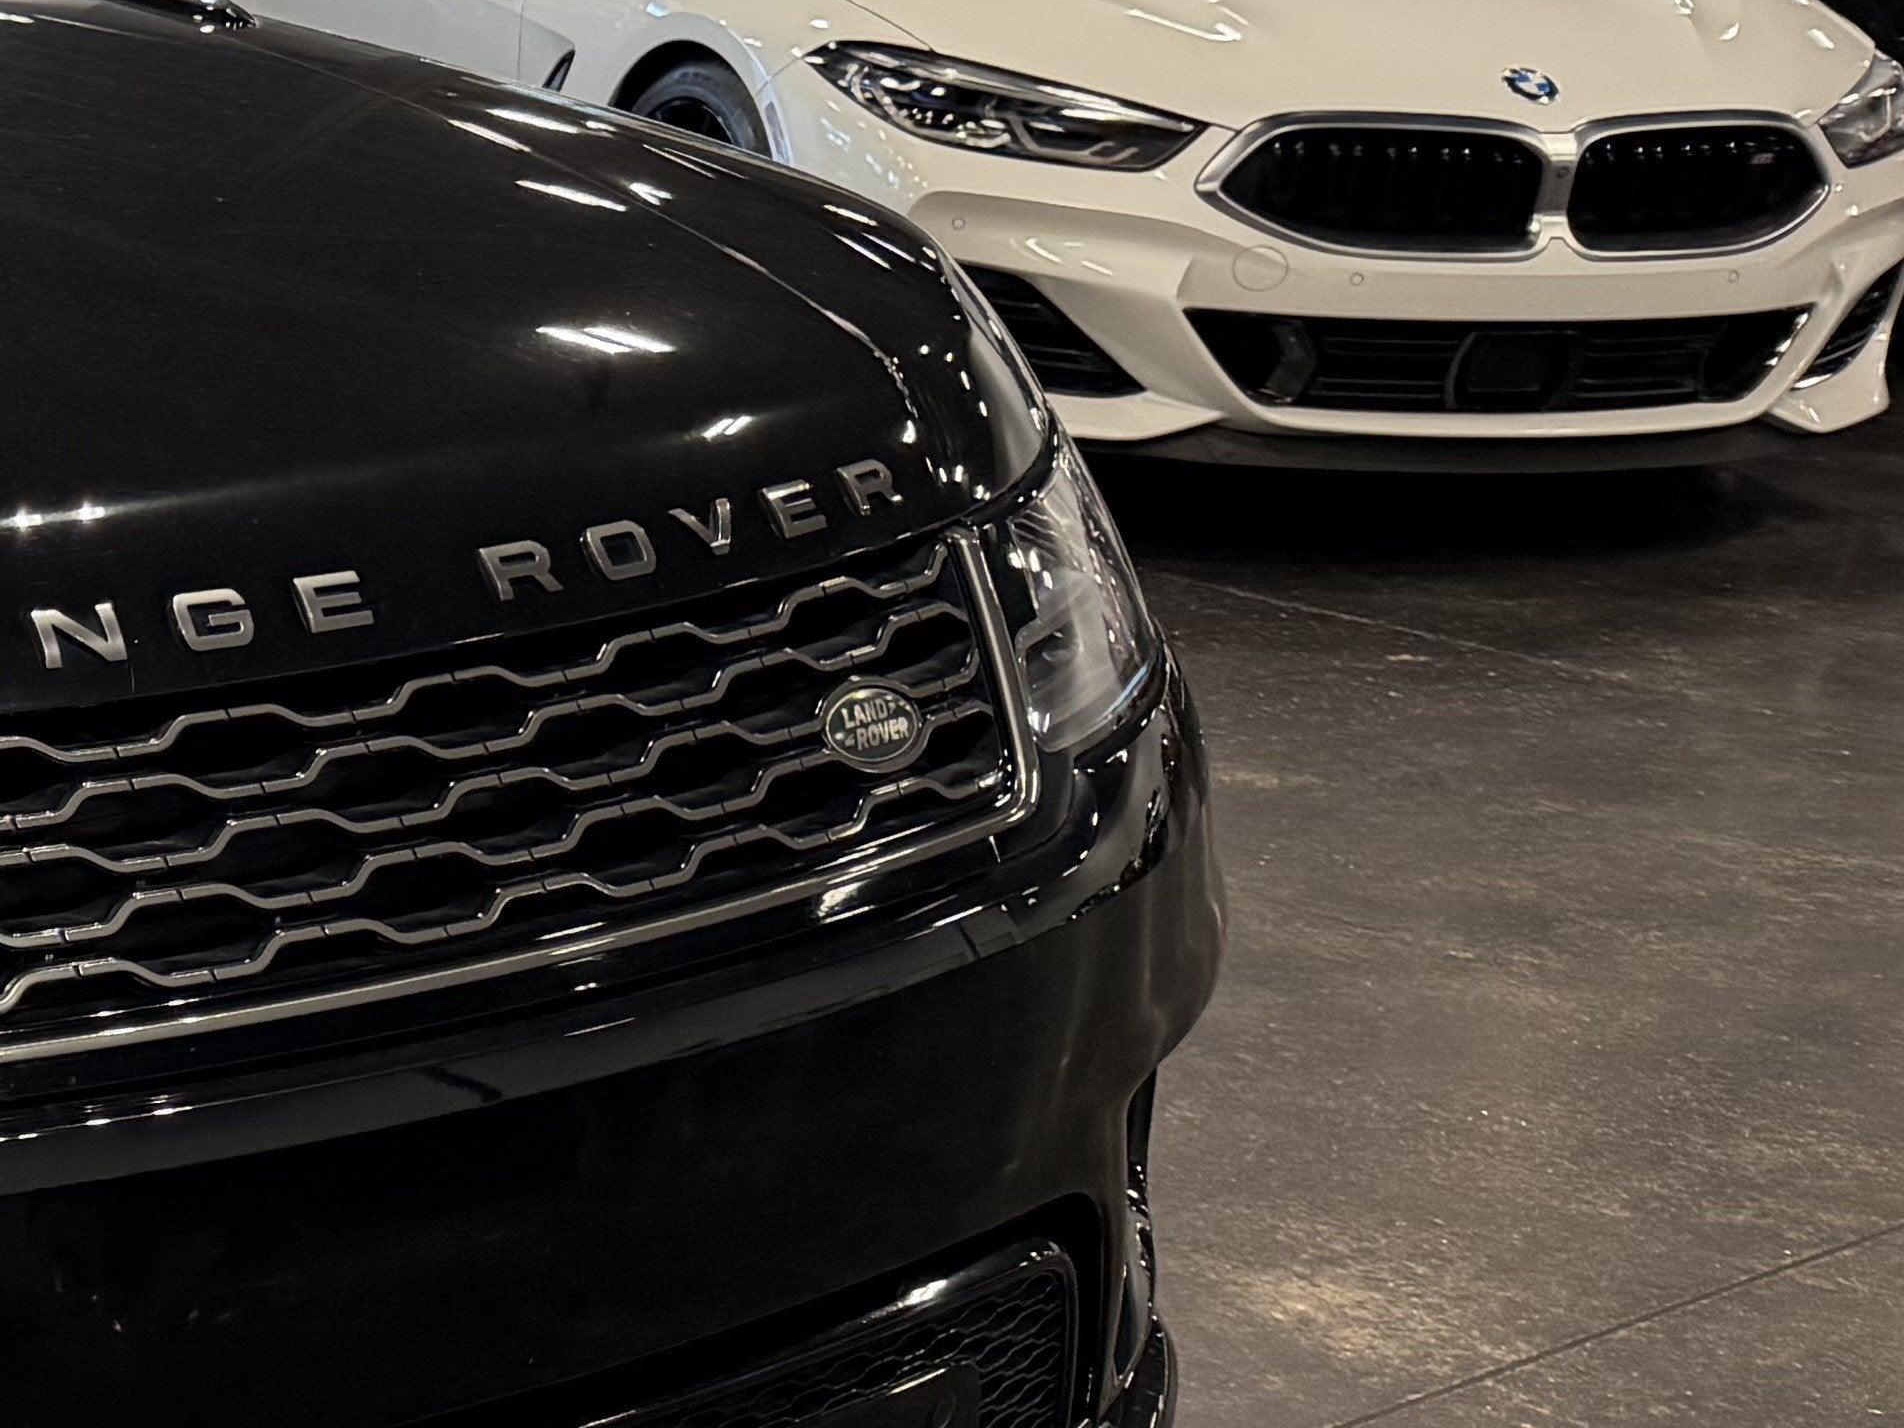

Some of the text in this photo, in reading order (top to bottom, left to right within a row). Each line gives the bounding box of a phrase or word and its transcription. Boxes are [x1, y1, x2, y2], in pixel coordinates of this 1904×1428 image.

[477, 459, 903, 601] ROVER
[841, 698, 889, 730] LAND
[856, 716, 909, 751] ROVER
